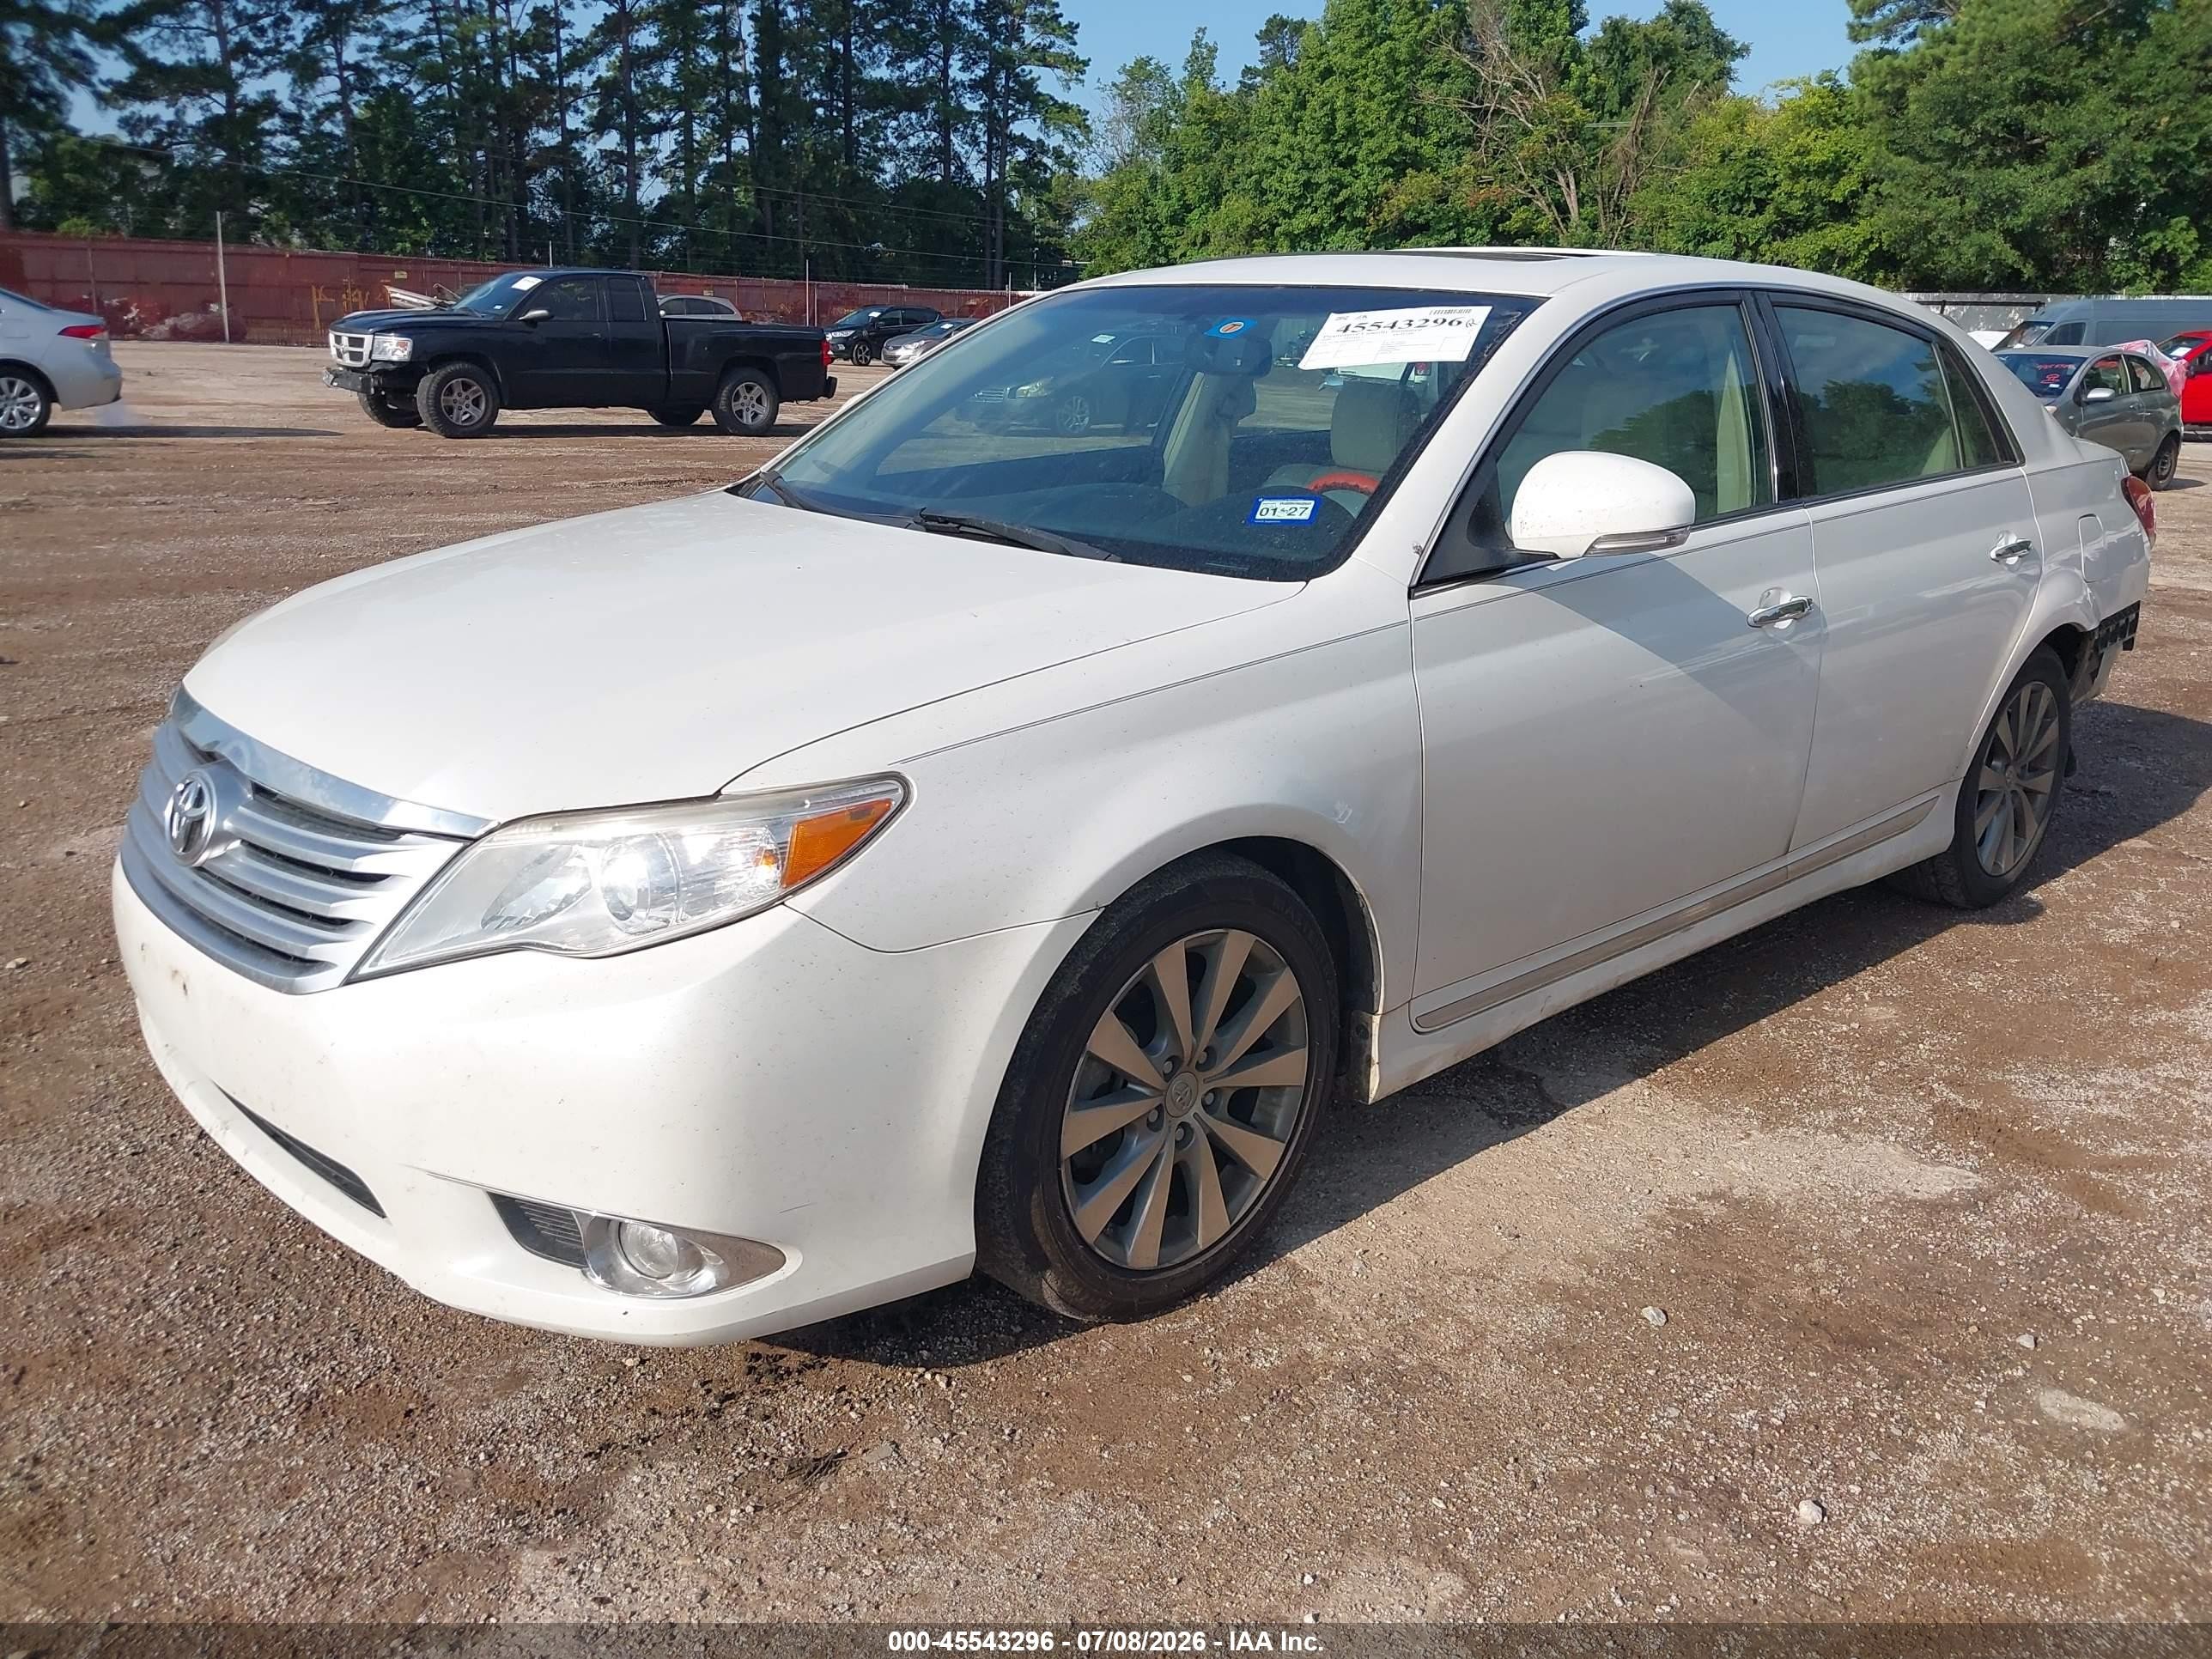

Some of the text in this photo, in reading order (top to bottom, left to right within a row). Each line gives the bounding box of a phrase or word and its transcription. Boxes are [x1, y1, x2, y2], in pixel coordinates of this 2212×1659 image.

[1336, 316, 1464, 333] 45543296
[1259, 507, 1310, 517] 01 27
